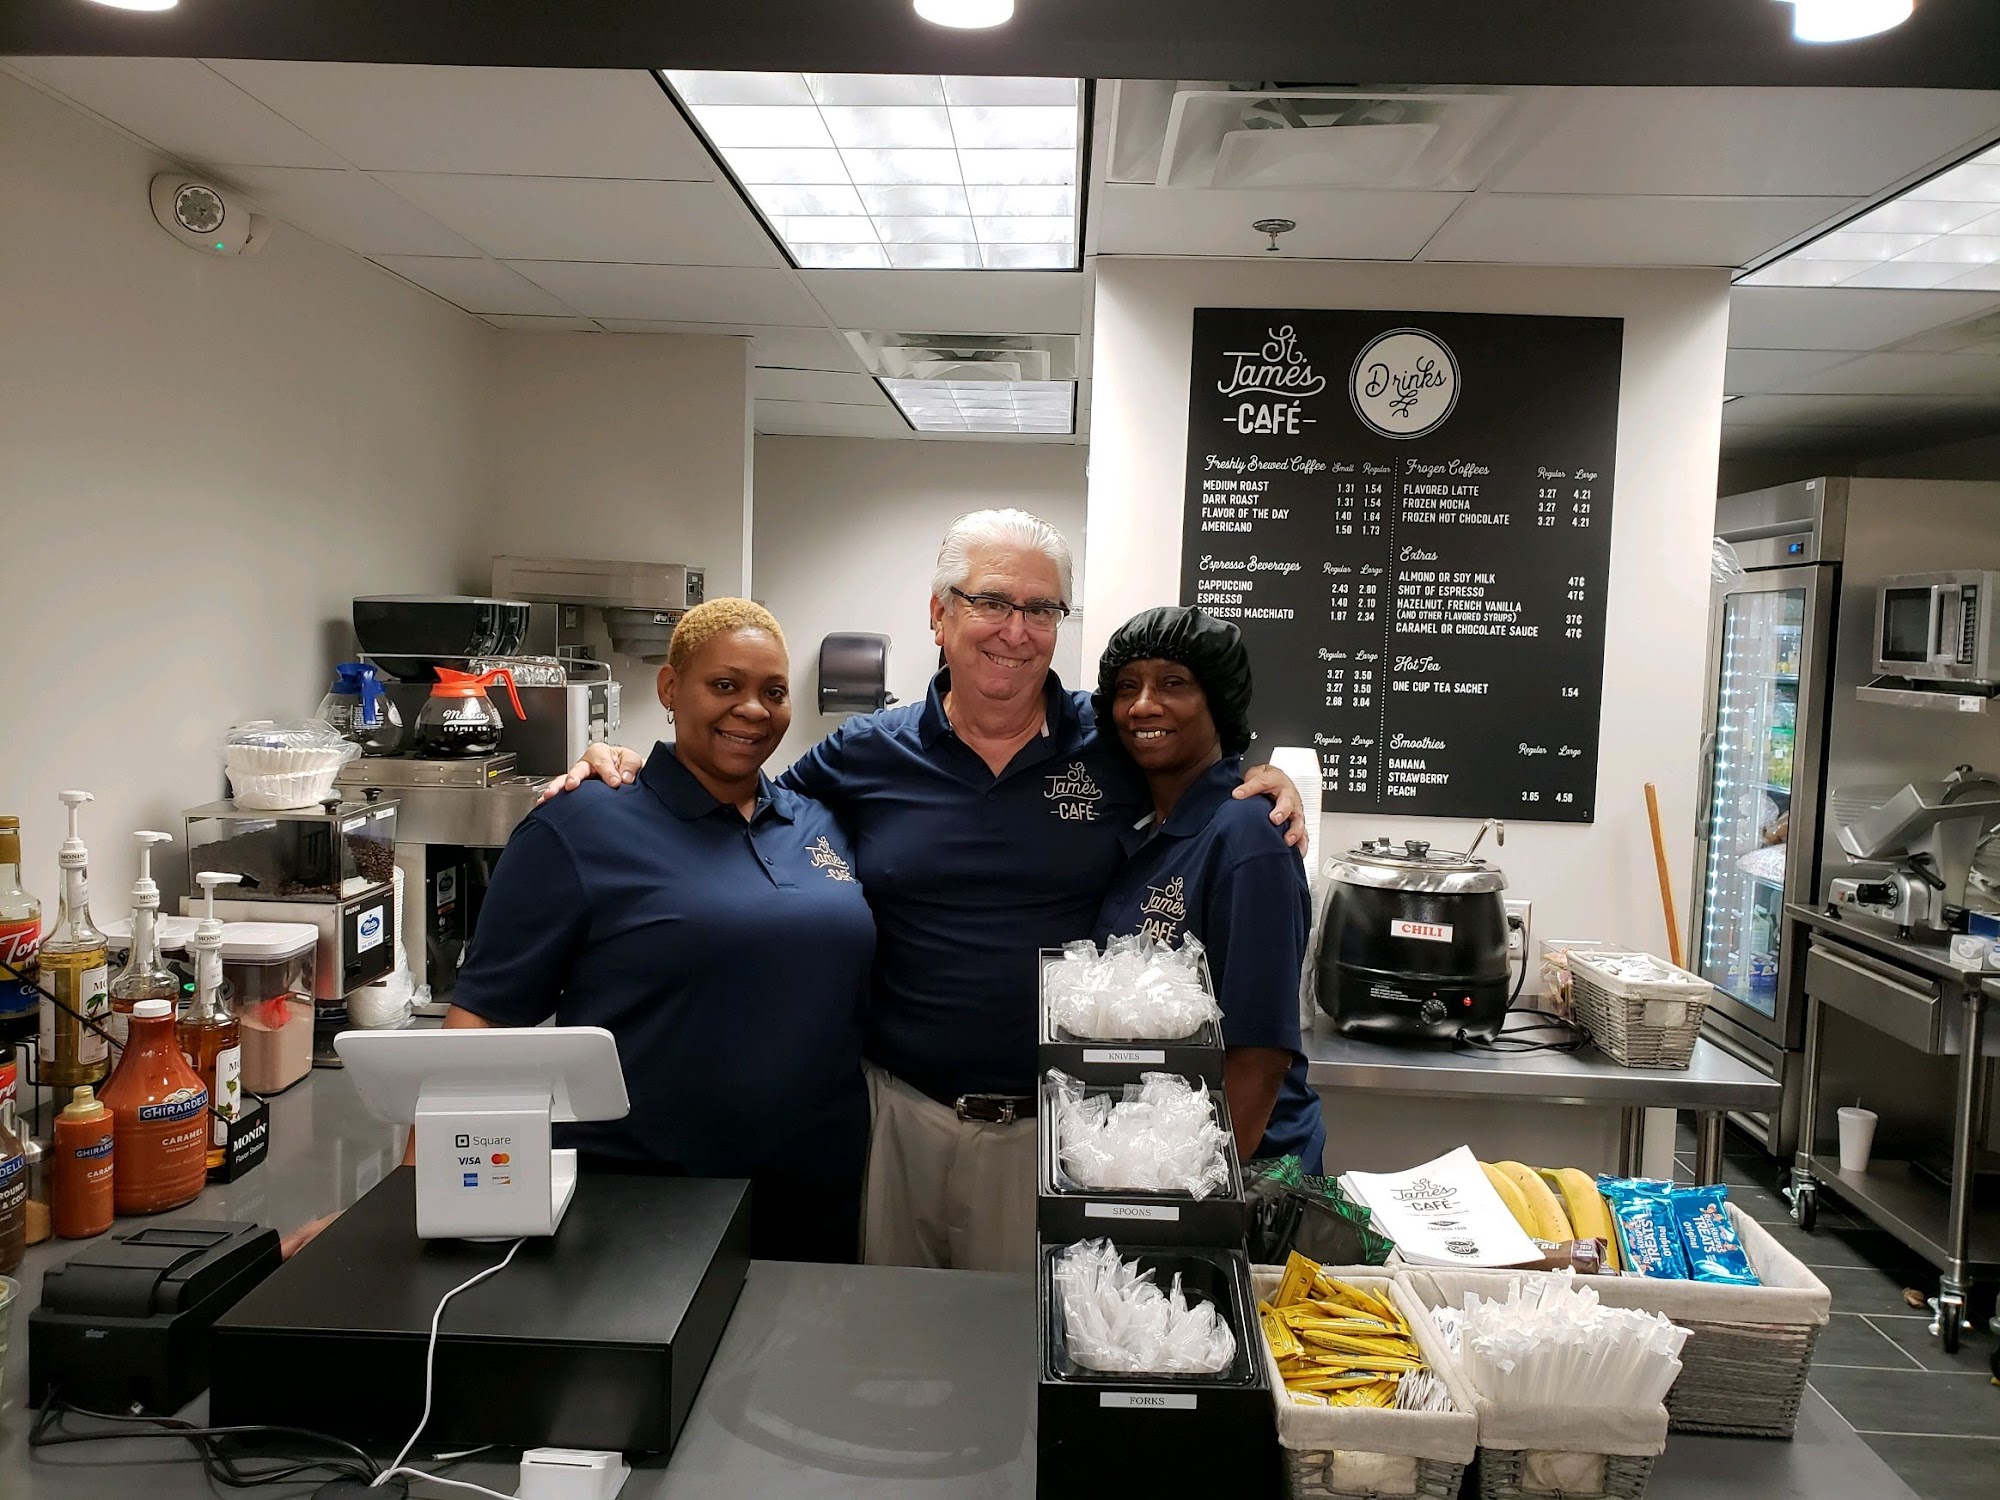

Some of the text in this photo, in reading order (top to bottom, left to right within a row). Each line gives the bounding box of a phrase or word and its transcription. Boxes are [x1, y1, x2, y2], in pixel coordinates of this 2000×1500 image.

[1262, 324, 1308, 364] St.
[1217, 352, 1326, 398] James
[1365, 356, 1447, 398] Drinks
[1238, 400, 1302, 435] CAFÉ
[1204, 454, 1391, 475] Freshly Brewed Coffee Small Regular
[1404, 458, 1598, 482] Frozen Coffees Regular Large
[1203, 480, 1382, 494] MEDIUM ROAST 1.31 1.54
[1403, 484, 1591, 500] FLAVORED LATTE 3.27 4.21
[1202, 494, 1381, 507] DARK ROAST 1.31 1.54
[1402, 498, 1590, 513] FROZEN MOCHA 3.27 4.21
[1201, 507, 1235, 518] FLAVOR
[1238, 508, 1249, 518] OF
[1252, 508, 1268, 519] THE
[1272, 509, 1290, 519] DAY
[1335, 511, 1352, 520] 1.40
[1402, 512, 1589, 527] FROZEN HOT CHOCOLATE 3.27 4.21
[1201, 521, 1380, 535] AMERICANO 1.50 1.73
[1399, 546, 1438, 562] Extras
[1199, 555, 1383, 576] Espresso Beverages Regular Large
[1398, 571, 1435, 582] ALMOND
[1439, 572, 1450, 582] OR
[1453, 573, 1471, 583] SOY
[1474, 573, 1496, 584] MILK
[1198, 580, 1377, 594] CAPPUCCINO 2.43 2.80
[1398, 585, 1421, 595] SHOT
[1425, 586, 1436, 596] OF
[1439, 586, 1484, 597] ESPRESSO
[1198, 593, 1376, 608] ESPRESSO 1.40 2.10
[1448, 600, 1482, 611] FRENCH
[1485, 601, 1522, 612] VANILLA
[1244, 608, 1294, 619] MACCHIATO
[1330, 611, 1347, 620] 1.87
[1357, 612, 1375, 622] 2.34
[1396, 611, 1416, 620] (AND
[1419, 611, 1442, 620] OTHER
[1444, 612, 1481, 621] FLAVORED
[1483, 613, 1517, 623] SYRUPS)
[1396, 623, 1438, 634] CARAMEL
[1441, 624, 1452, 634] OR
[1455, 624, 1506, 636] CHOCOLATE
[1509, 625, 1539, 637] SAUCE
[1318, 648, 1378, 662] Regular Large
[1394, 656, 1441, 673] Hot Tea
[1327, 669, 1372, 680] 3.27 3.50
[1326, 683, 1371, 693] 3.27 3.50
[1392, 681, 1579, 697] ONE CUP TEA SACHET 1.54
[1352, 698, 1370, 707] 3.04
[1313, 732, 1374, 747] Regular Large
[1389, 733, 1581, 758] Smoothies Regular Large
[1350, 756, 1367, 765] 2.34
[1388, 759, 1426, 770] BANANA
[1067, 762, 1092, 782] St.
[1322, 768, 1367, 778] 3.04 3.50
[1388, 772, 1449, 784] STRAWBERRY
[1044, 776, 1103, 800] James
[1322, 781, 1366, 792] 3.04 3.50
[1387, 785, 1416, 796] PEACH
[1556, 793, 1573, 803] 4.58
[1059, 801, 1095, 820] CAFÉ
[1402, 924, 1443, 937] CHILI
[162, 1128, 203, 1146] CARAMEL
[233, 1124, 266, 1152] MONIN
[473, 1137, 511, 1147] Square
[236, 1142, 264, 1164] Flavor Station
[458, 1157, 481, 1165] VISA
[1412, 1198, 1453, 1211] CAFÉ
[1113, 1208, 1151, 1216] SPOONS
[1641, 1219, 1662, 1262] TREATS
[1693, 1216, 1716, 1253] TREATS
[1130, 1397, 1164, 1405] FORKS
